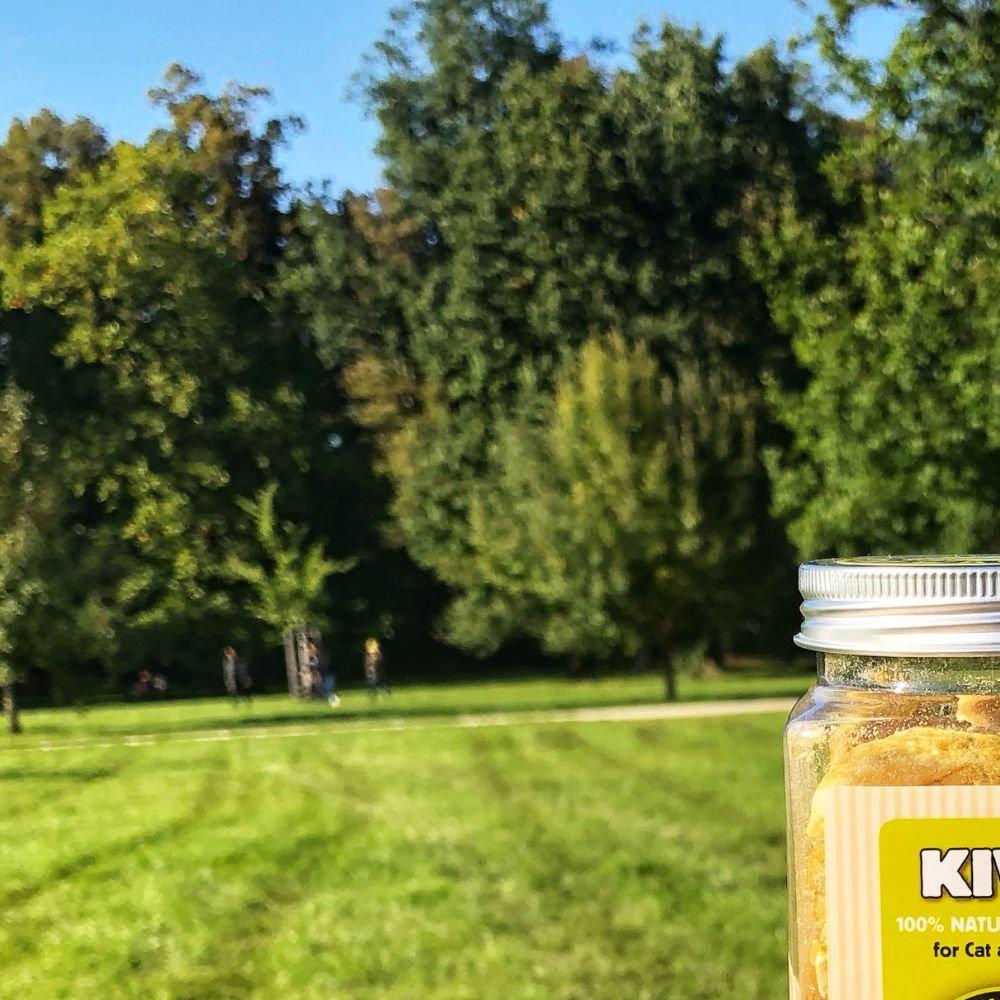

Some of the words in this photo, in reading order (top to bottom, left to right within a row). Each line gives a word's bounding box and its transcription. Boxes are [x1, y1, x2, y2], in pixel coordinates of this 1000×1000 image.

[897, 917, 944, 933] 100%
[933, 943, 960, 957] for
[965, 943, 992, 957] Cat
